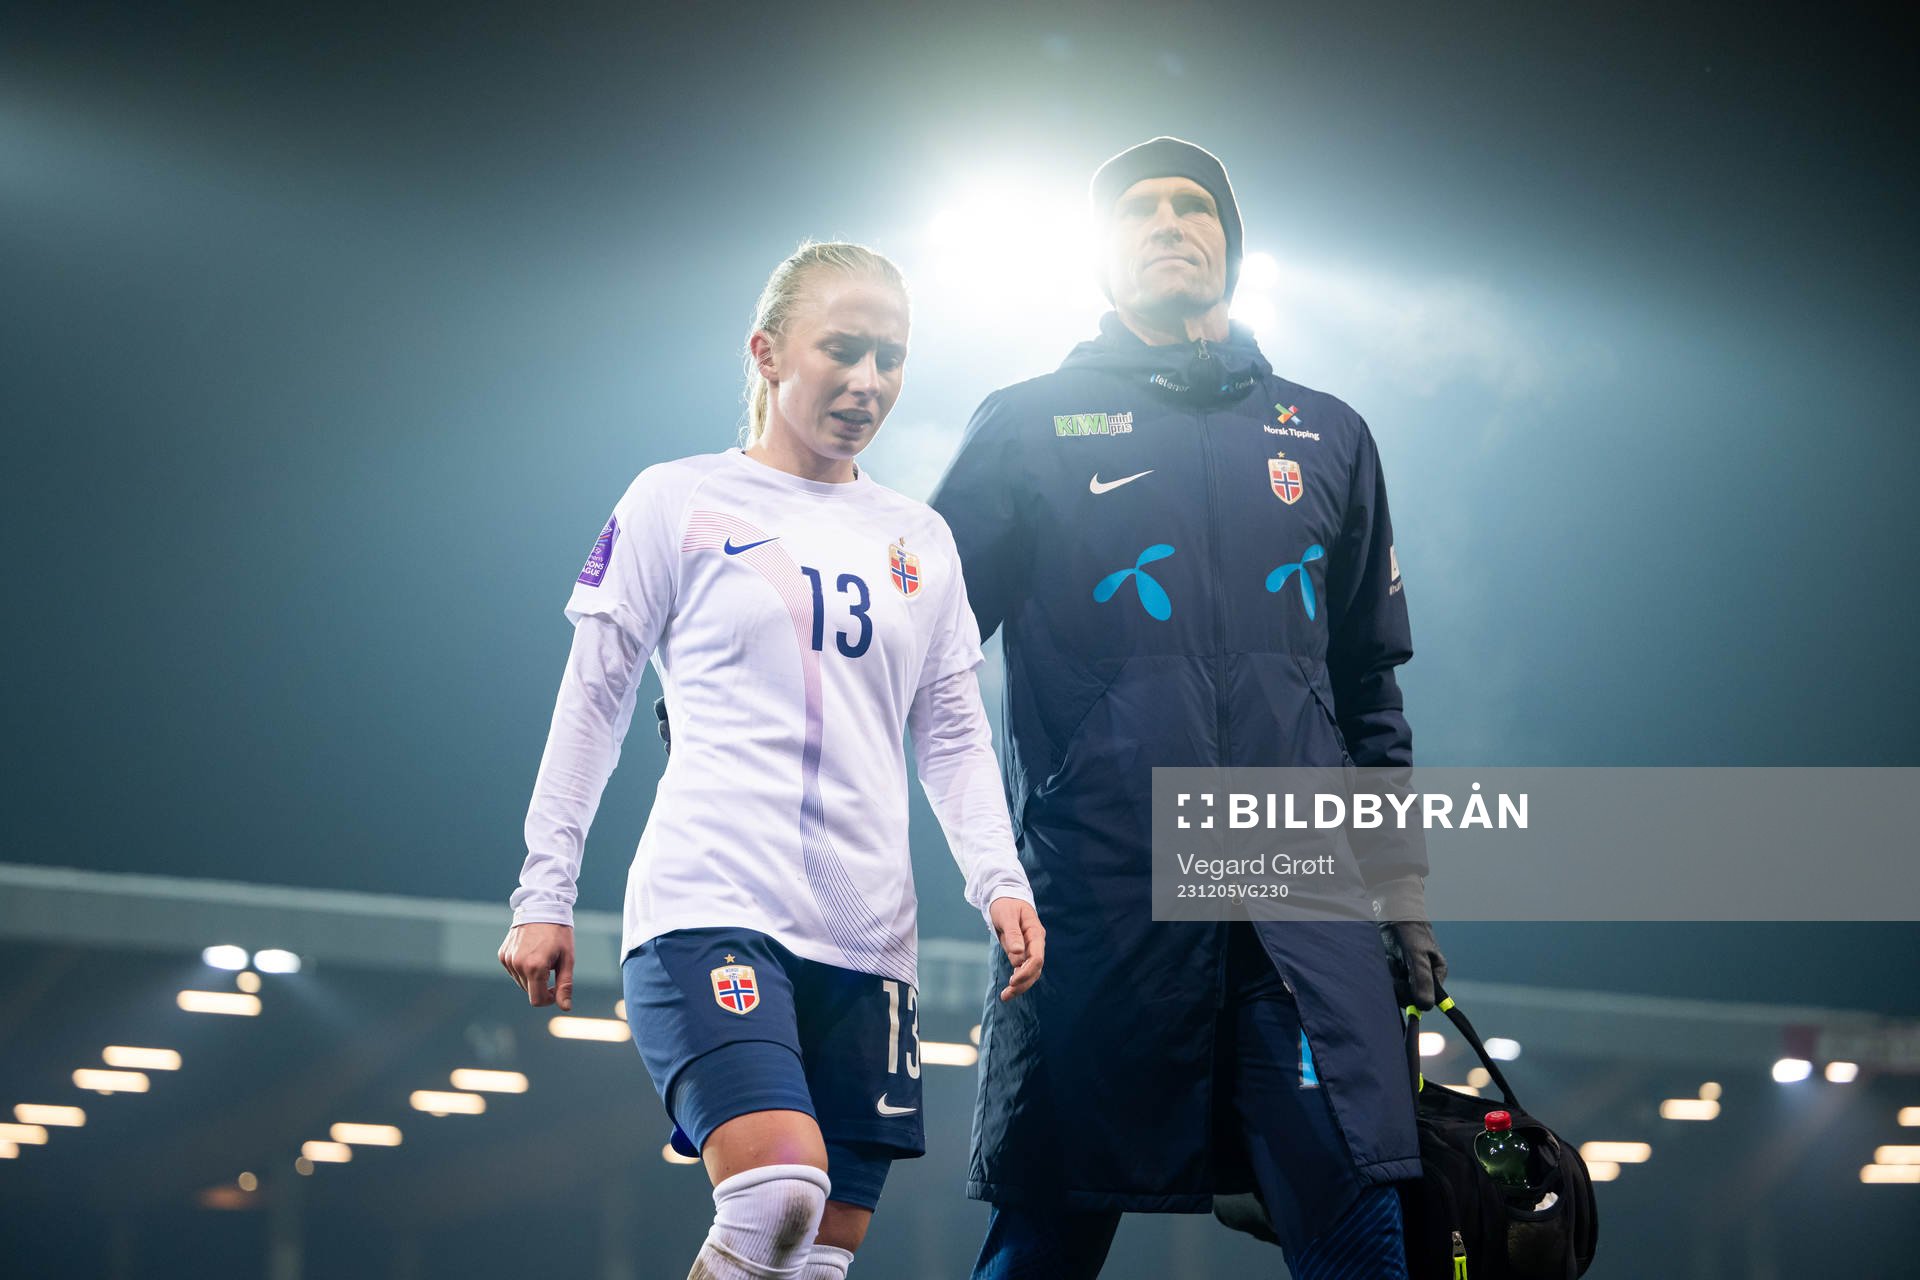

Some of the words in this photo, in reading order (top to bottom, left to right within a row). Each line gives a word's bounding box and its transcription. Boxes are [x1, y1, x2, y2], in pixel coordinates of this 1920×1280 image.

[1054, 413, 1109, 436] KIWI
[1108, 411, 1133, 424] mini
[1109, 423, 1133, 436] pris
[1263, 425, 1288, 436] Norsk
[1289, 428, 1320, 441] Tipping
[801, 565, 873, 658] 13
[882, 979, 921, 1080] 13
